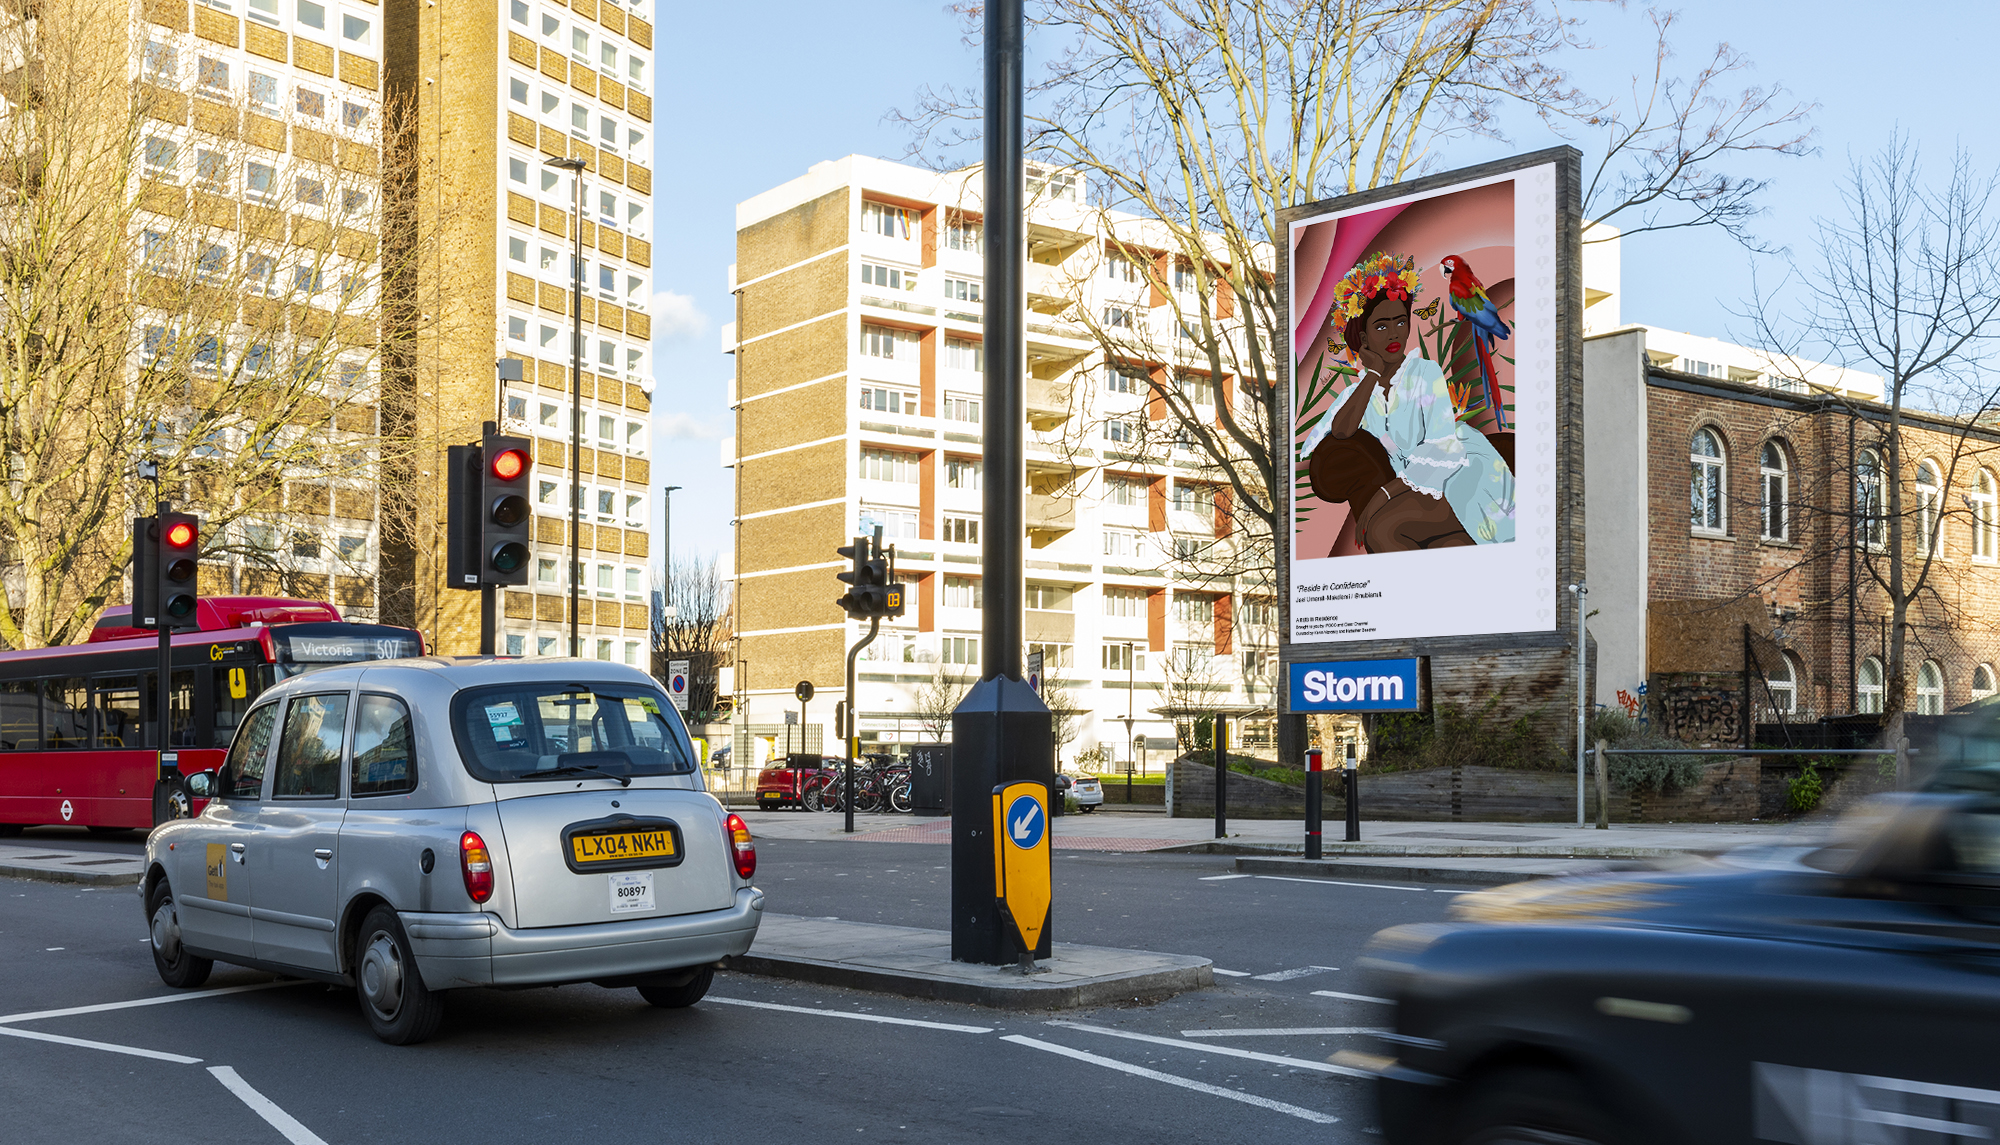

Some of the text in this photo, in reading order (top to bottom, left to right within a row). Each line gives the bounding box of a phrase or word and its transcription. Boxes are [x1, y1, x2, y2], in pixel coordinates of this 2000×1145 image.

[1322, 583, 1329, 591] in
[888, 592, 900, 607] 03
[300, 642, 353, 656] Victoria
[377, 640, 399, 659] 507
[1302, 669, 1405, 703] Storm
[581, 833, 666, 856] LX04 NKH
[618, 886, 646, 897] 80897
